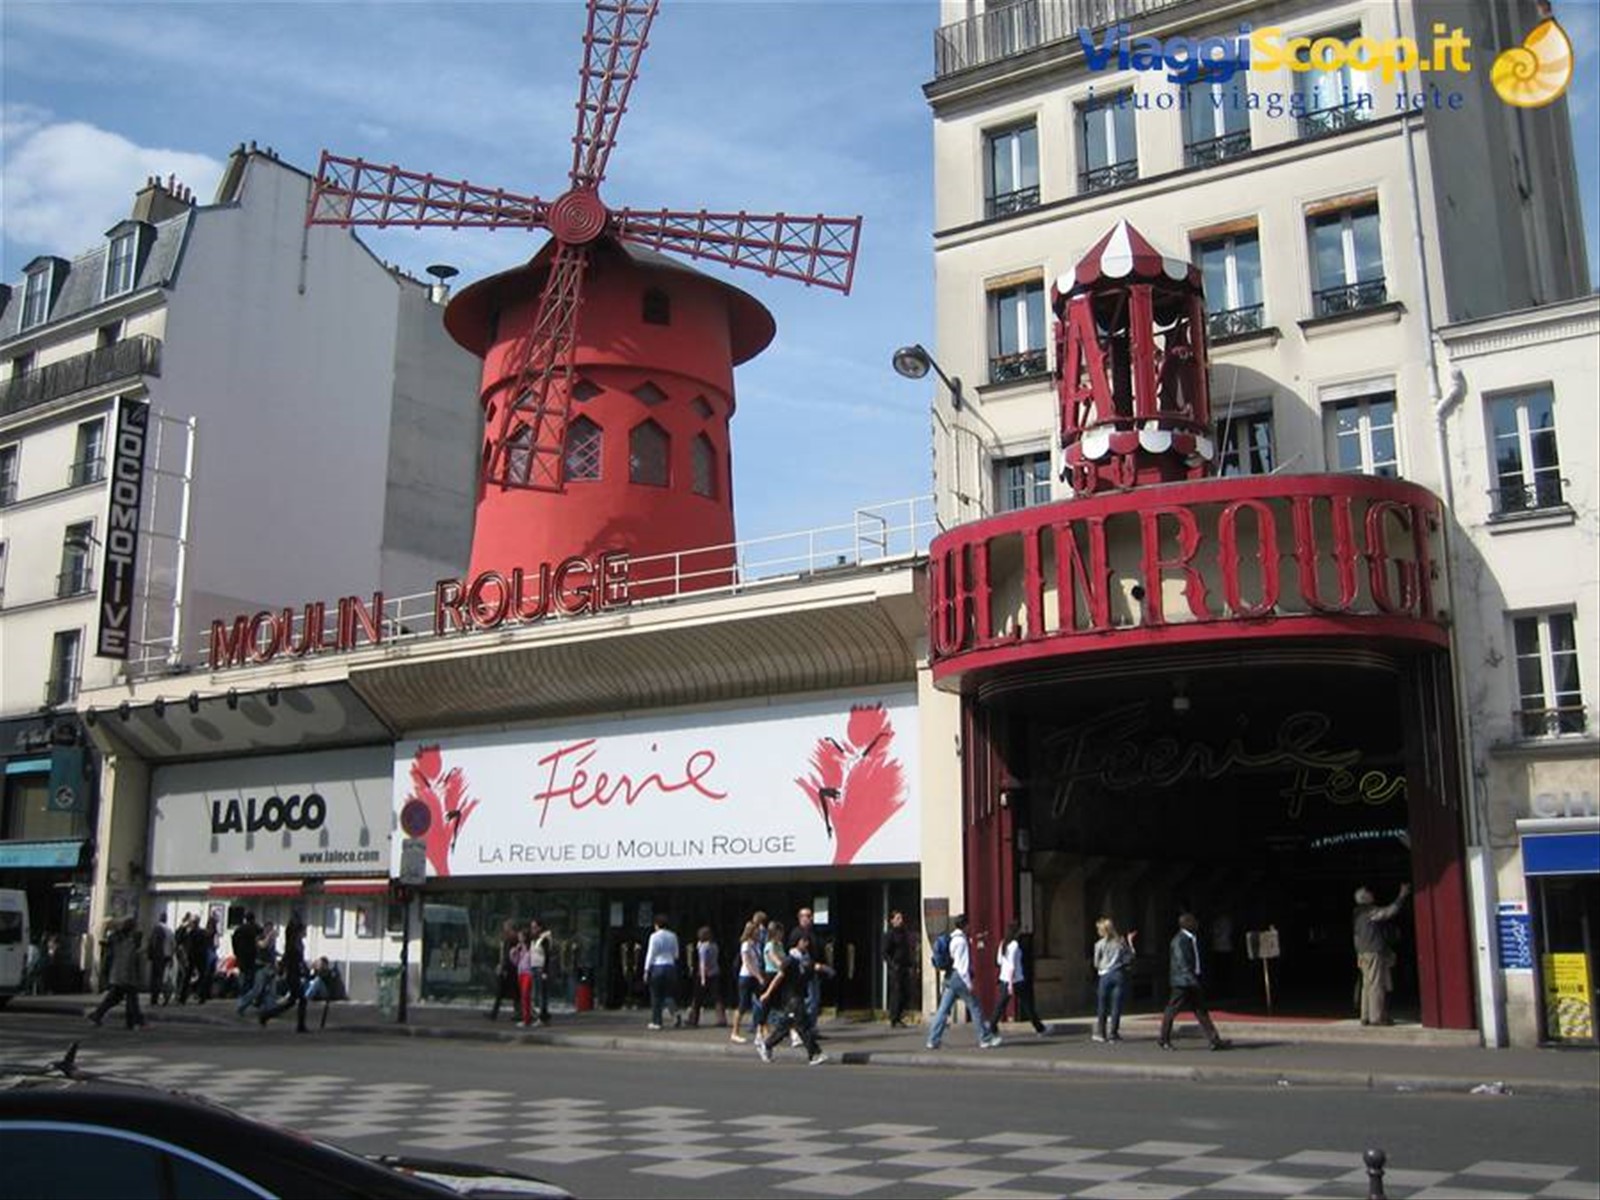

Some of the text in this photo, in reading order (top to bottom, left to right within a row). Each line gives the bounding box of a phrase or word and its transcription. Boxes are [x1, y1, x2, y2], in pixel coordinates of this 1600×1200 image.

[103, 407, 144, 655] LOCOMOTIVE
[209, 550, 632, 669] MOULIN ROUGE
[212, 792, 327, 835] LA LOCO
[299, 850, 380, 865] www.laloco.com
[478, 835, 797, 864] LA REVUE DU MOULIN ROUGE
